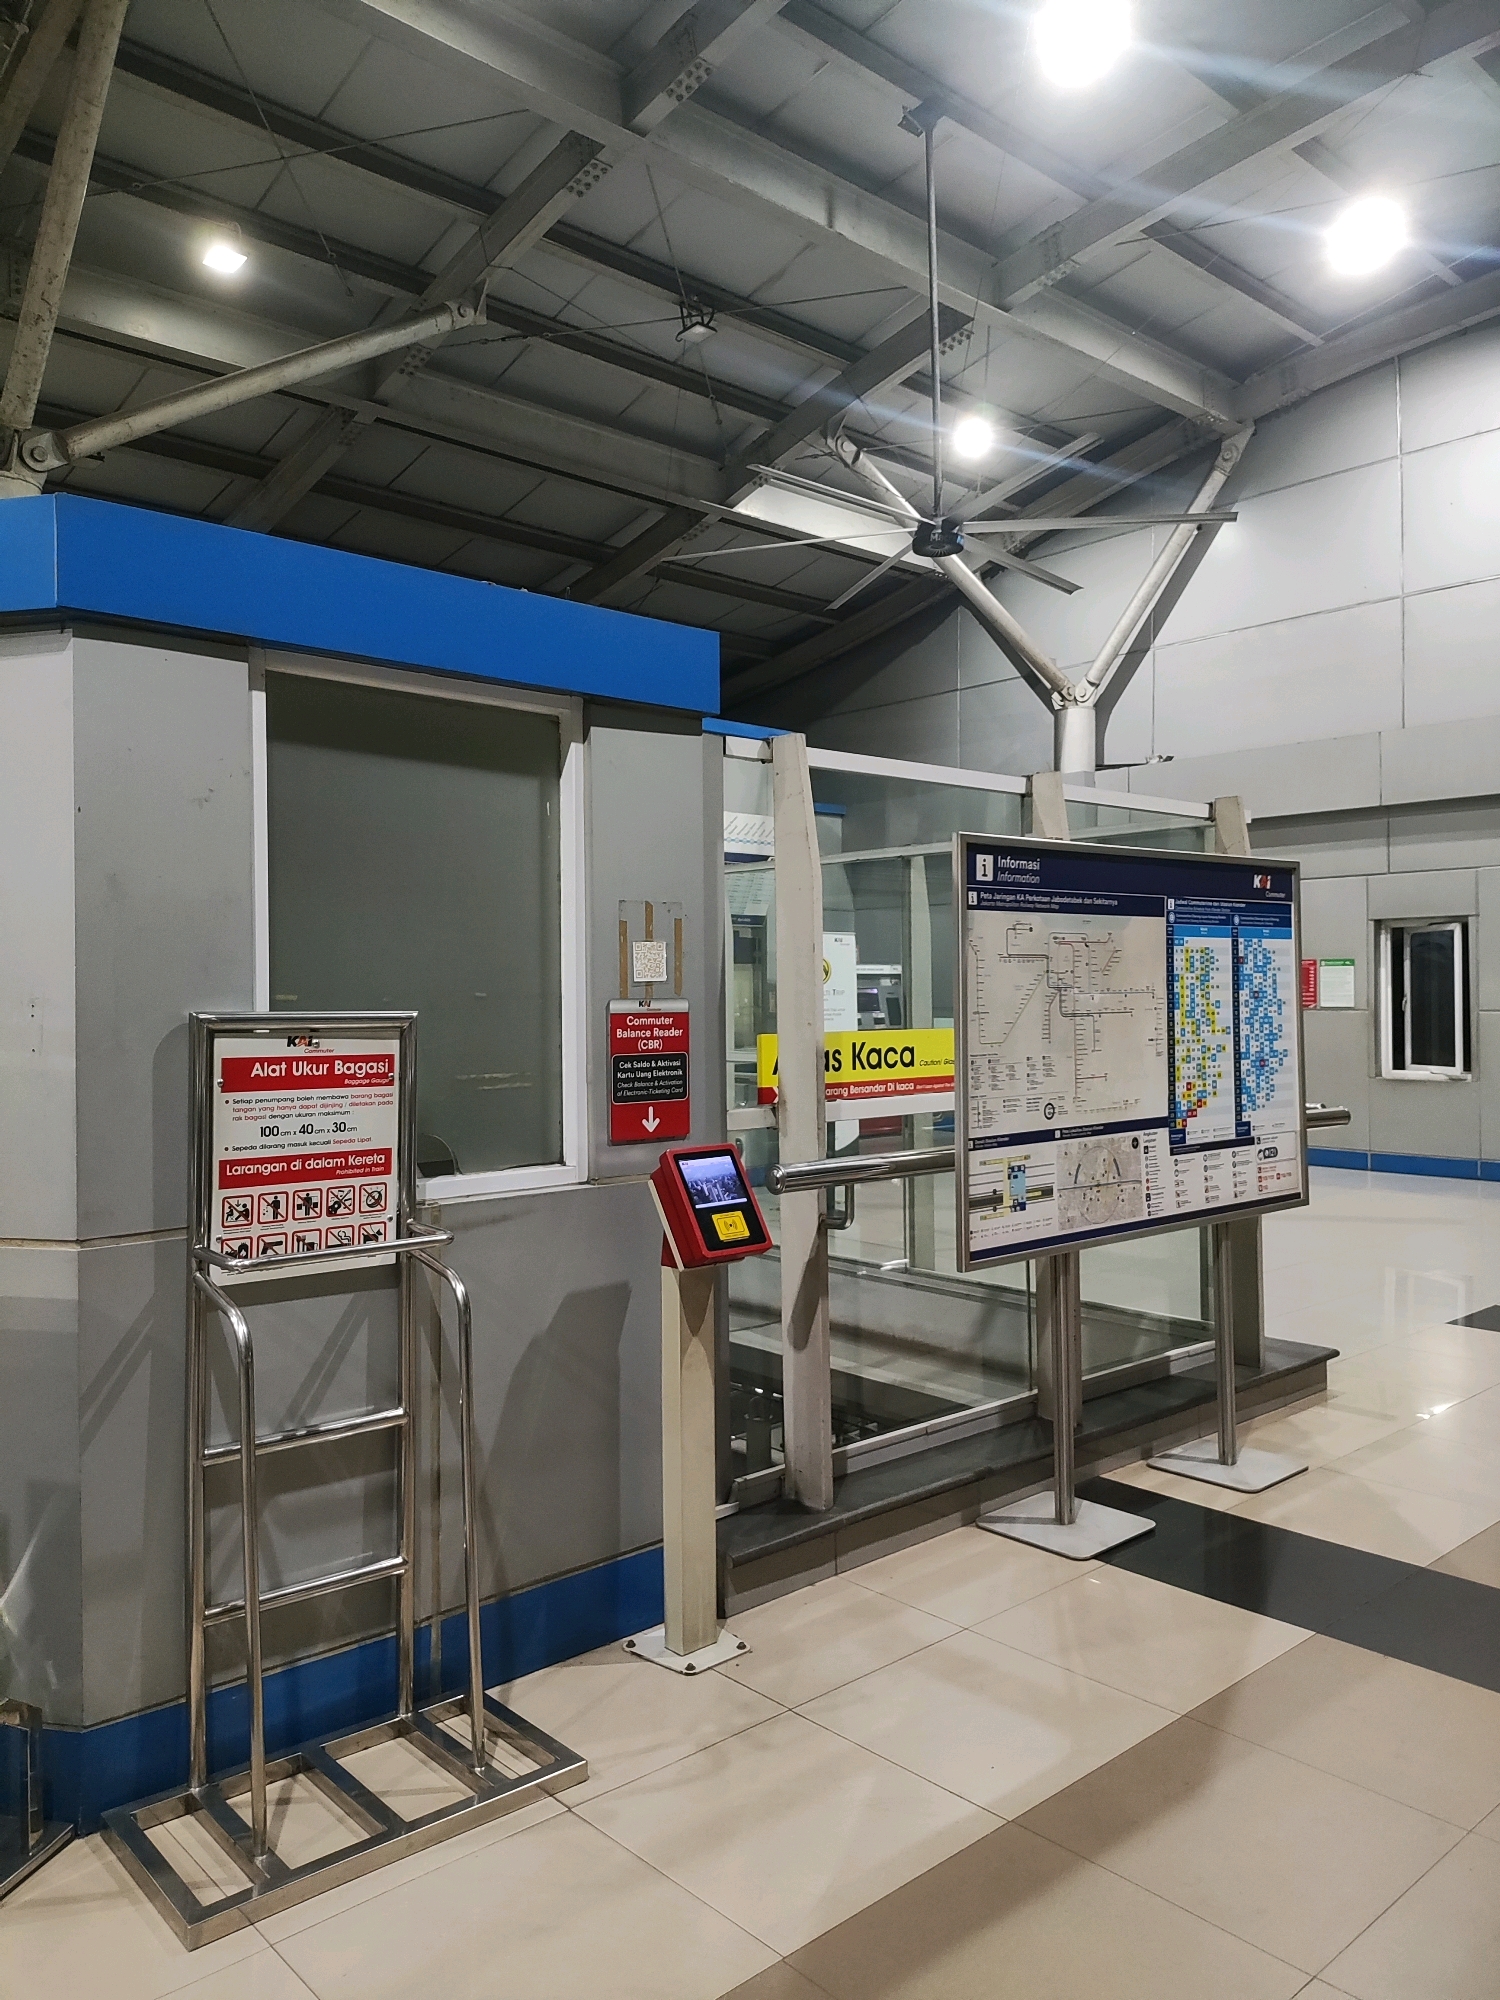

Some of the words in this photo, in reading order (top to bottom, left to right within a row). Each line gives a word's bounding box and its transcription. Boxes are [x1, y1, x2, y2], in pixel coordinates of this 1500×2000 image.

[998, 856, 1040, 871] Informasi
[997, 871, 1040, 884] Information
[980, 892, 992, 900] Peta
[993, 892, 1016, 902] Jaringan
[1266, 890, 1286, 898] Commuter
[626, 1016, 673, 1026] Commuter
[616, 1028, 652, 1039] Balance
[653, 1027, 684, 1038] Reader
[637, 1040, 663, 1050] (CBR)
[852, 1042, 915, 1070] Kaca
[250, 1061, 287, 1077] Alat
[292, 1061, 329, 1076] Ukur
[334, 1059, 389, 1078] Bagasi
[618, 1061, 632, 1069] Cek
[632, 1060, 650, 1068] Saldo
[657, 1058, 681, 1067] Aktivasi
[617, 1071, 635, 1079] Kartu
[636, 1071, 652, 1079] Uang
[652, 1069, 683, 1077] Elektronik
[850, 1084, 886, 1095] Bersandar
[887, 1082, 895, 1091] Di
[896, 1082, 914, 1091] kaca
[255, 1096, 295, 1105] penumpang
[298, 1103, 318, 1111] dapat
[320, 1102, 343, 1110] dijinjing
[268, 1112, 293, 1120] dengan
[260, 1125, 279, 1137] 100
[298, 1124, 314, 1135] 40
[332, 1122, 346, 1132] 30
[232, 1144, 257, 1152] Sepeda
[226, 1162, 287, 1176] Larangan
[290, 1159, 302, 1171] di
[305, 1156, 345, 1169] dalam
[348, 1153, 385, 1166] Kereta
[335, 1167, 364, 1175] Prohibited
